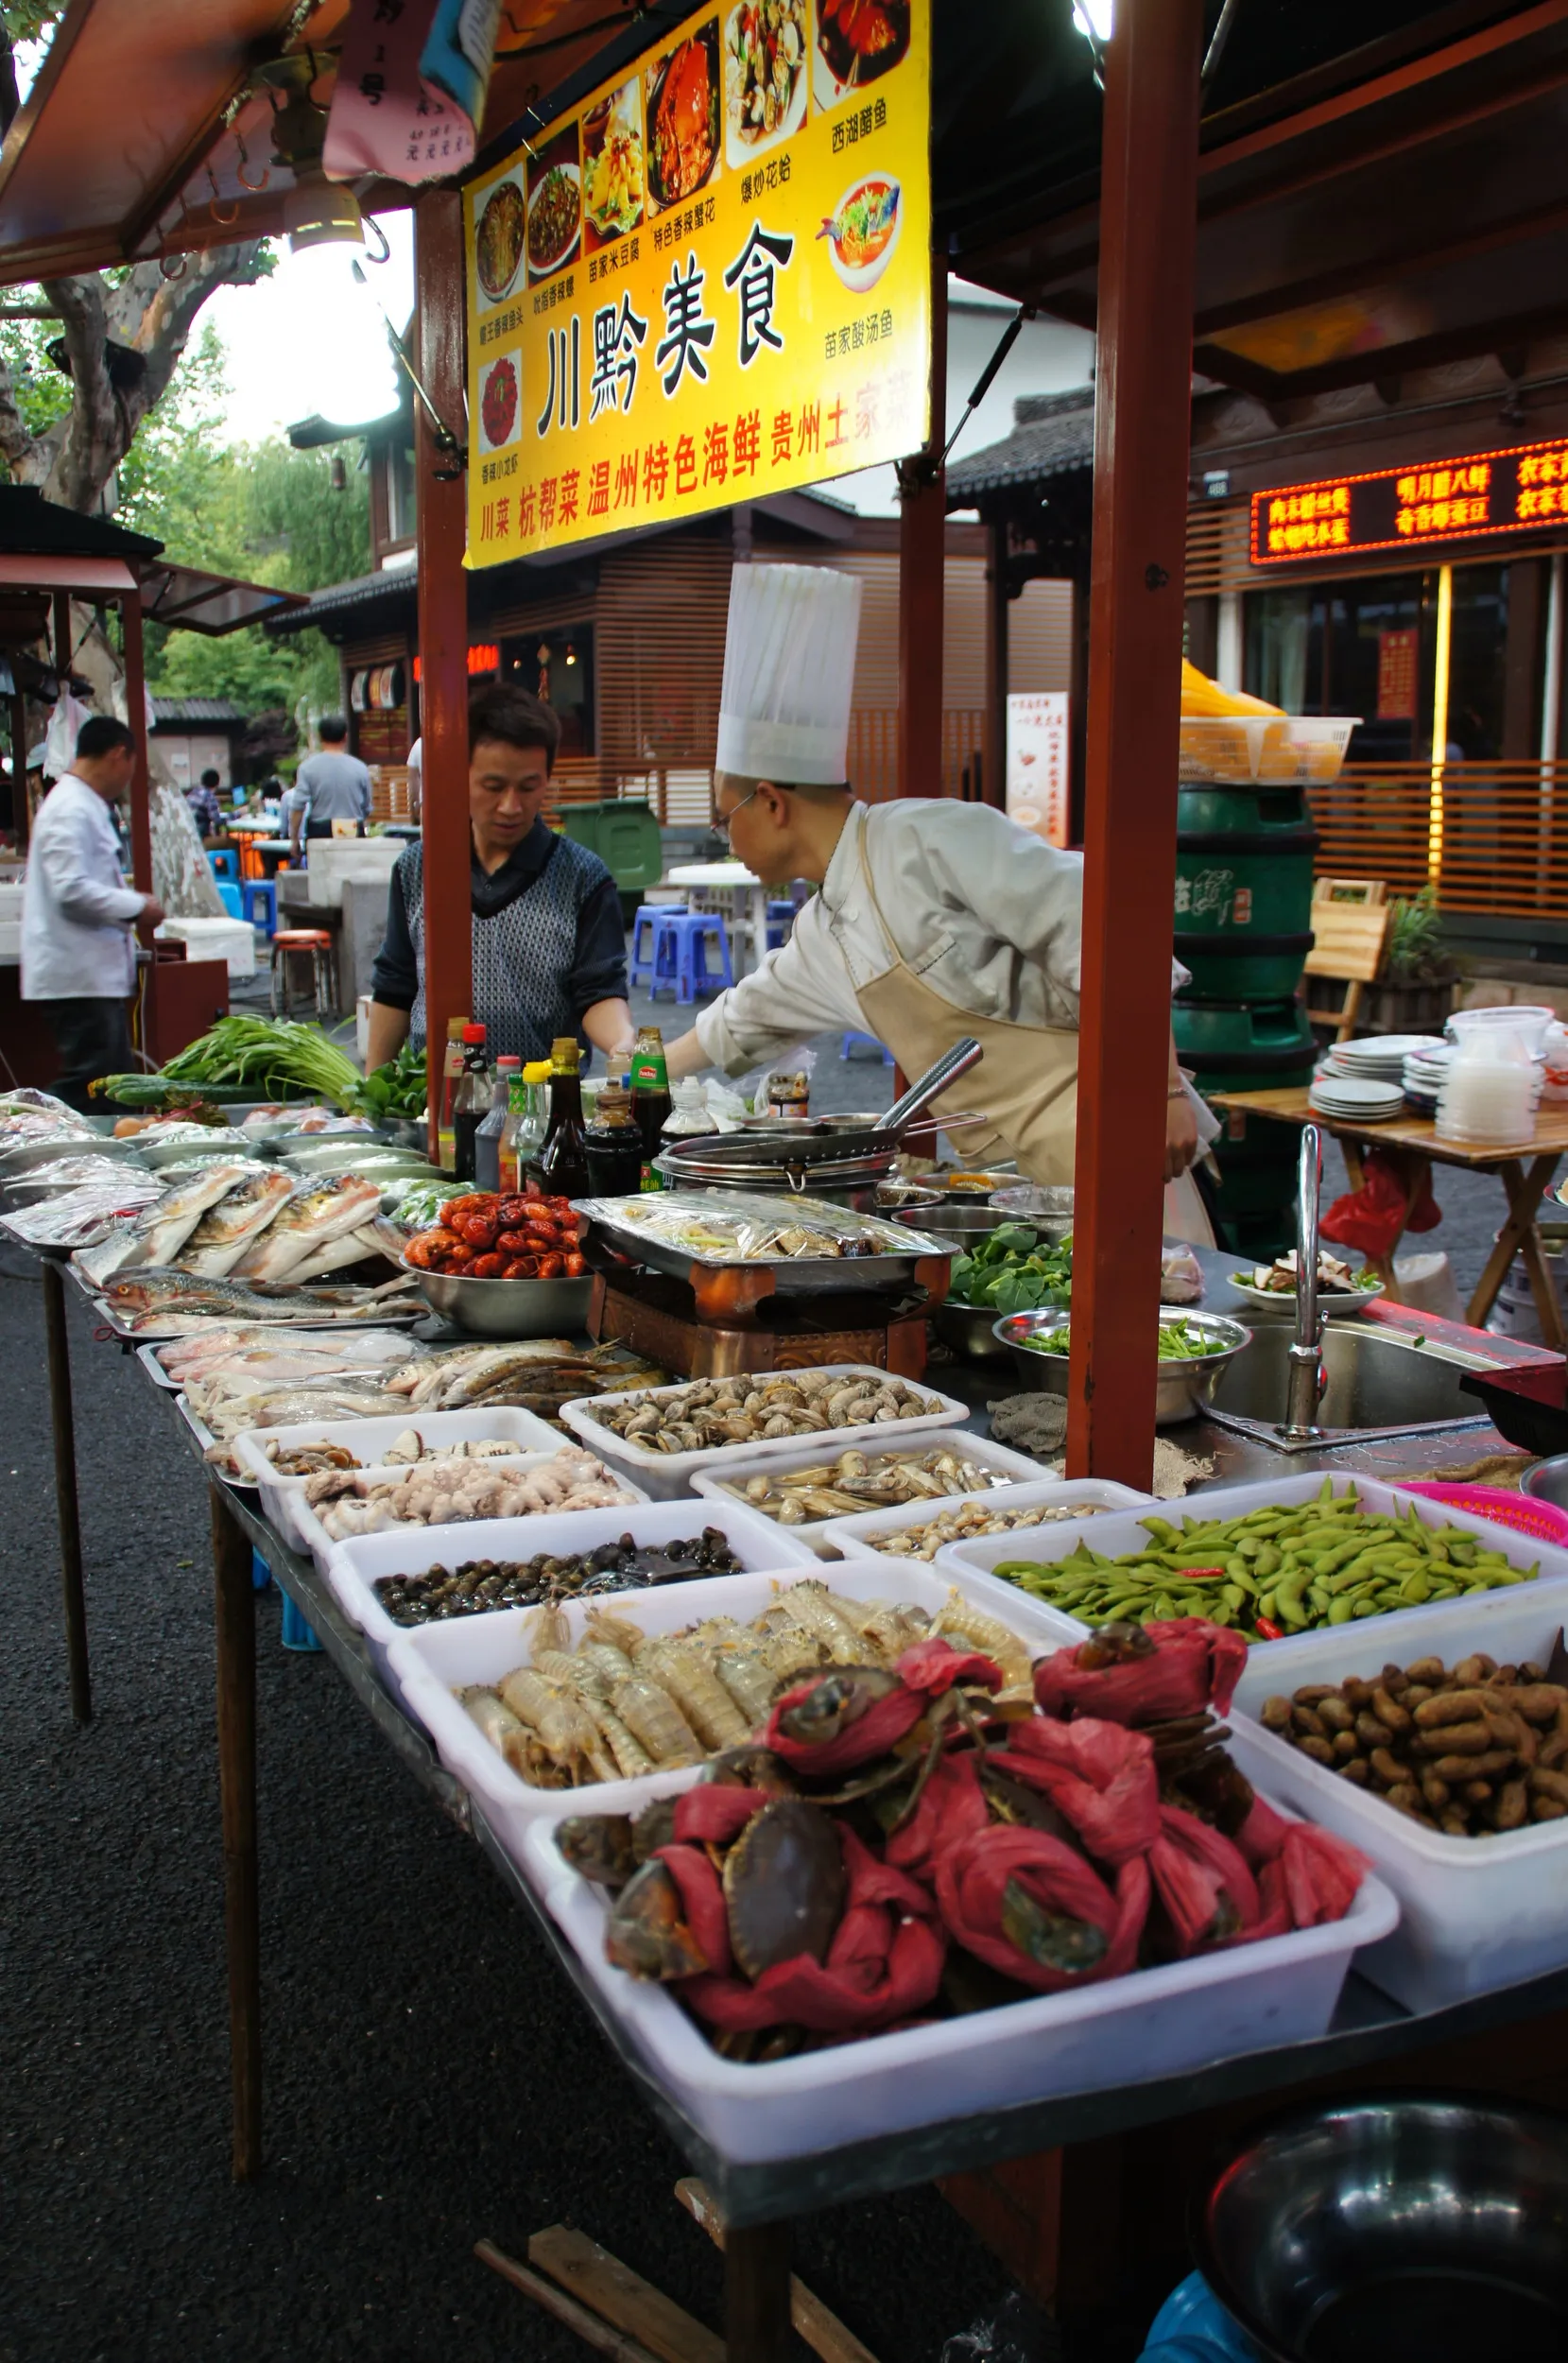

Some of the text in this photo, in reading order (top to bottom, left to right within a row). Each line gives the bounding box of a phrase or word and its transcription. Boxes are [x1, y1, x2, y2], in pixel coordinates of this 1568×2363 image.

[832, 95, 887, 154] 西湖醋鱼
[589, 237, 640, 284] 苗家米豆腐
[536, 222, 794, 437] 川黔美食
[824, 308, 892, 359] 苗家酸汤鱼
[480, 497, 509, 542] 川菜
[519, 469, 580, 539] 杭帮菜
[587, 408, 761, 516] 温州特色海鲜
